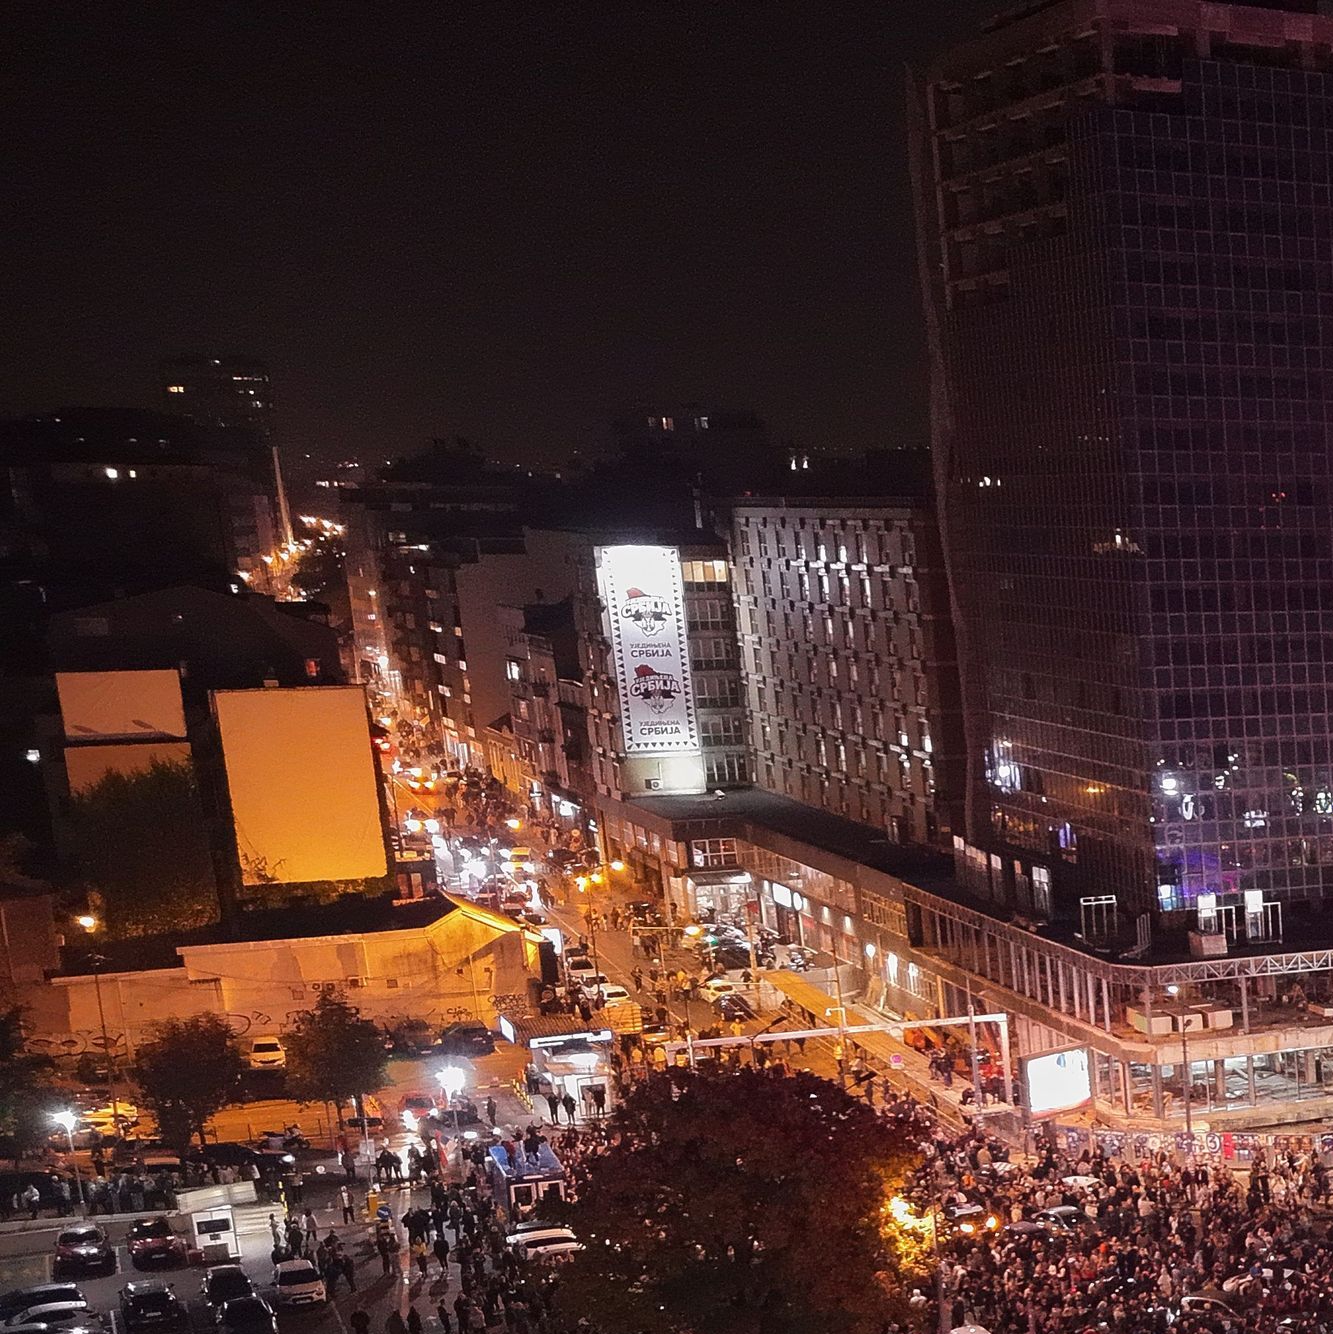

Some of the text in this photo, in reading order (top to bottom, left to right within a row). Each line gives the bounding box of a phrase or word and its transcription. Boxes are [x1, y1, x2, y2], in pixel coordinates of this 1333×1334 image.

[631, 649, 672, 658] СРБИЈА
[631, 680, 680, 696] СРБИЈА
[640, 727, 681, 735] СРБИЈА
